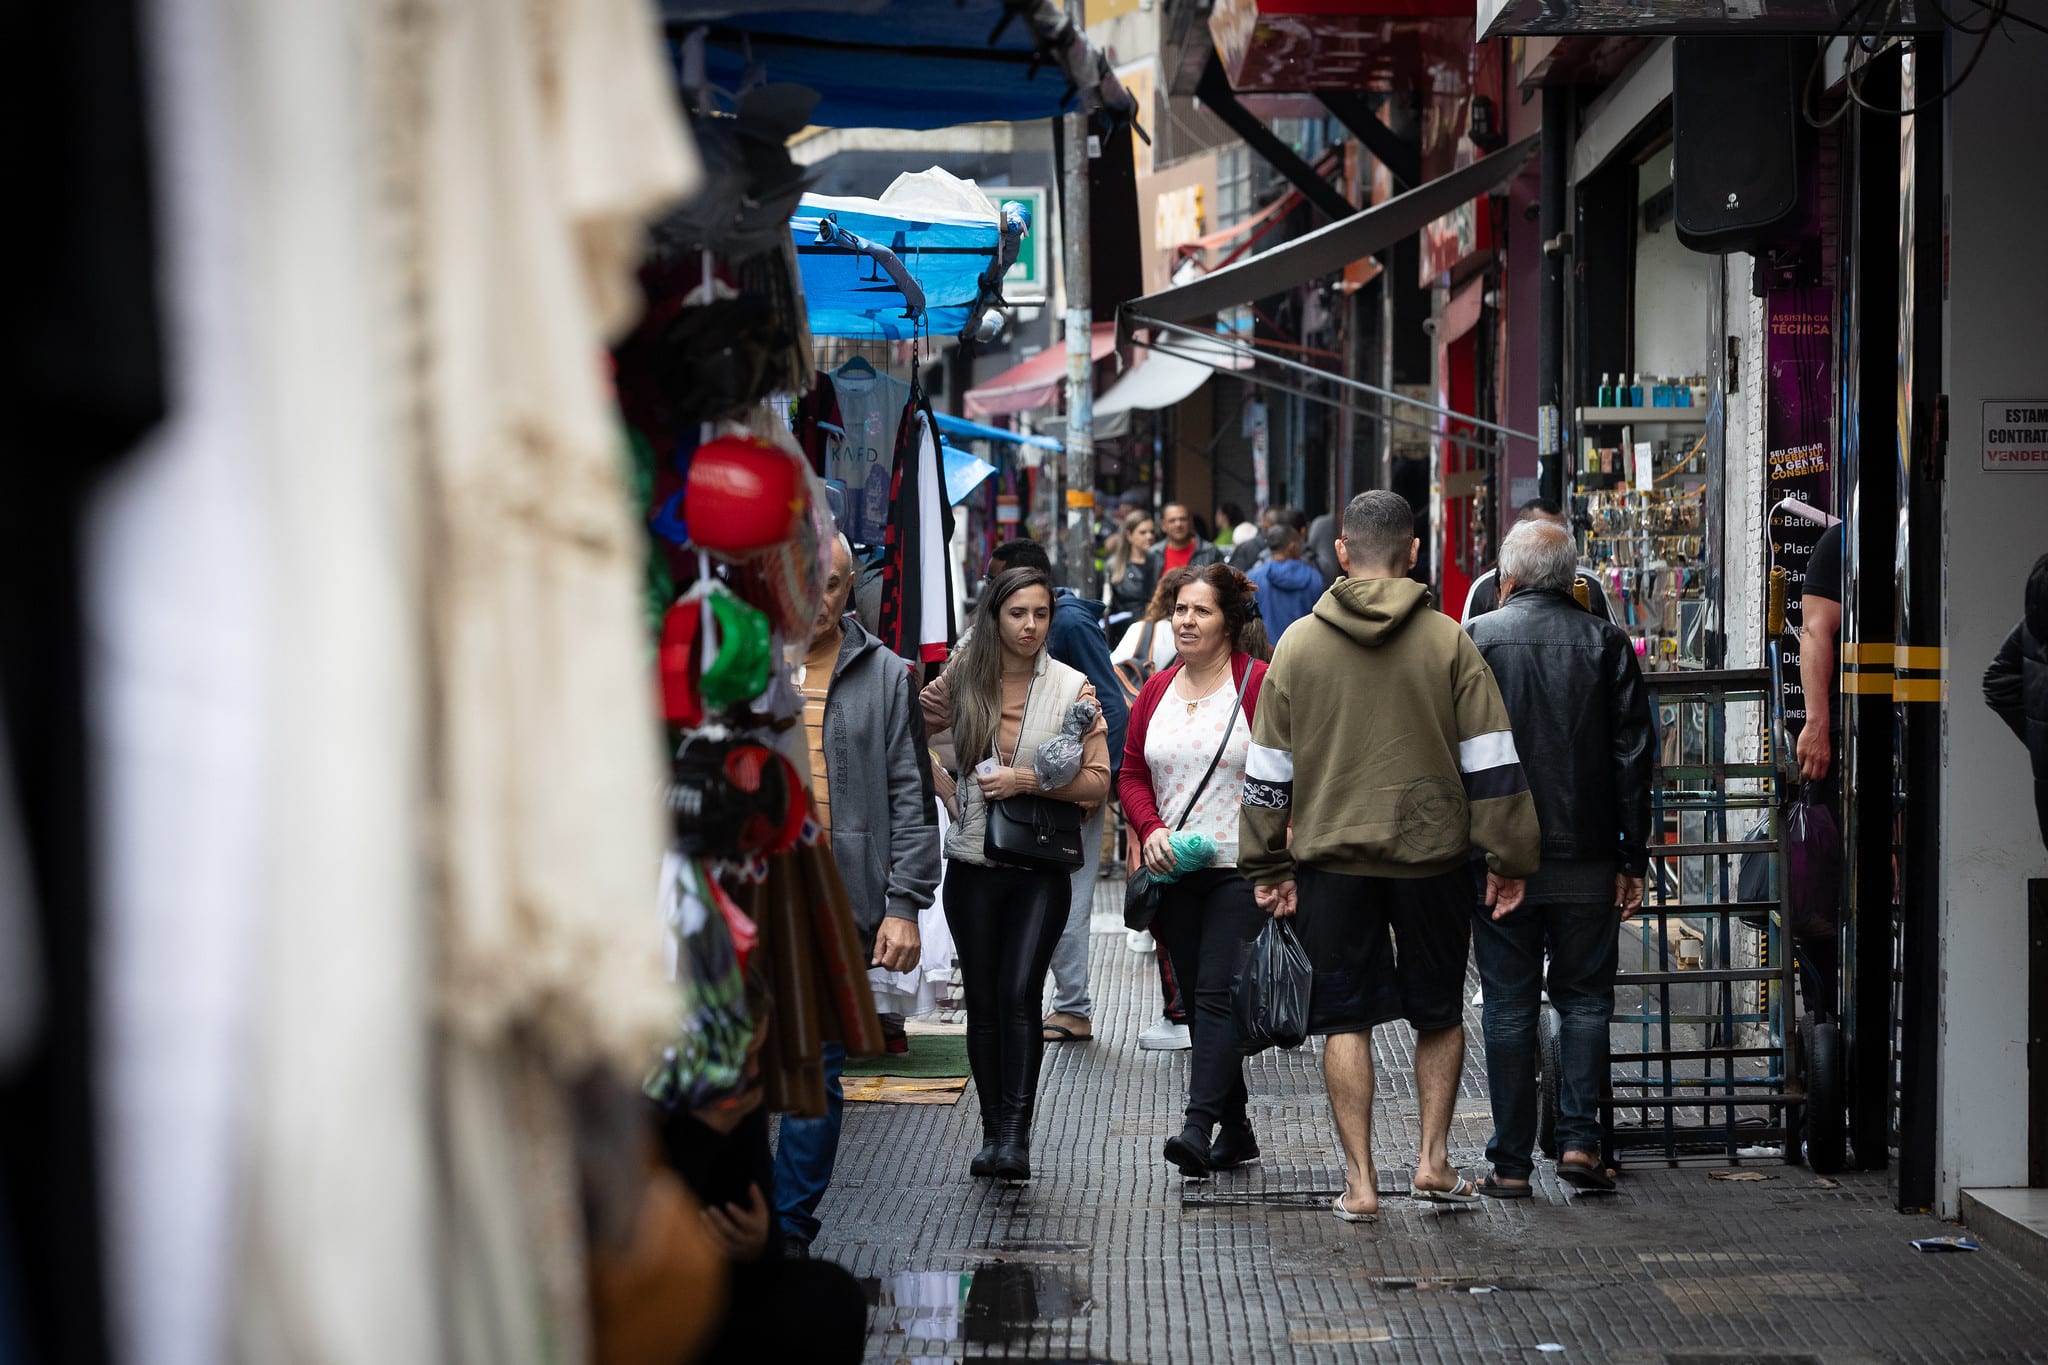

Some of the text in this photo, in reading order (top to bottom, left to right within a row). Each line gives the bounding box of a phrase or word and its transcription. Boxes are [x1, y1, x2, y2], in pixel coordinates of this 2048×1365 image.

[1771, 322, 1830, 335] TÉCNICA
[2006, 409, 2048, 423] ESTAM
[1770, 443, 1823, 458] SEU CELULAR
[1987, 451, 2048, 461] VENDED
[1774, 456, 1824, 473] A GENTE
[1783, 489, 1807, 500] Tela
[1783, 683, 1805, 694] Sin
